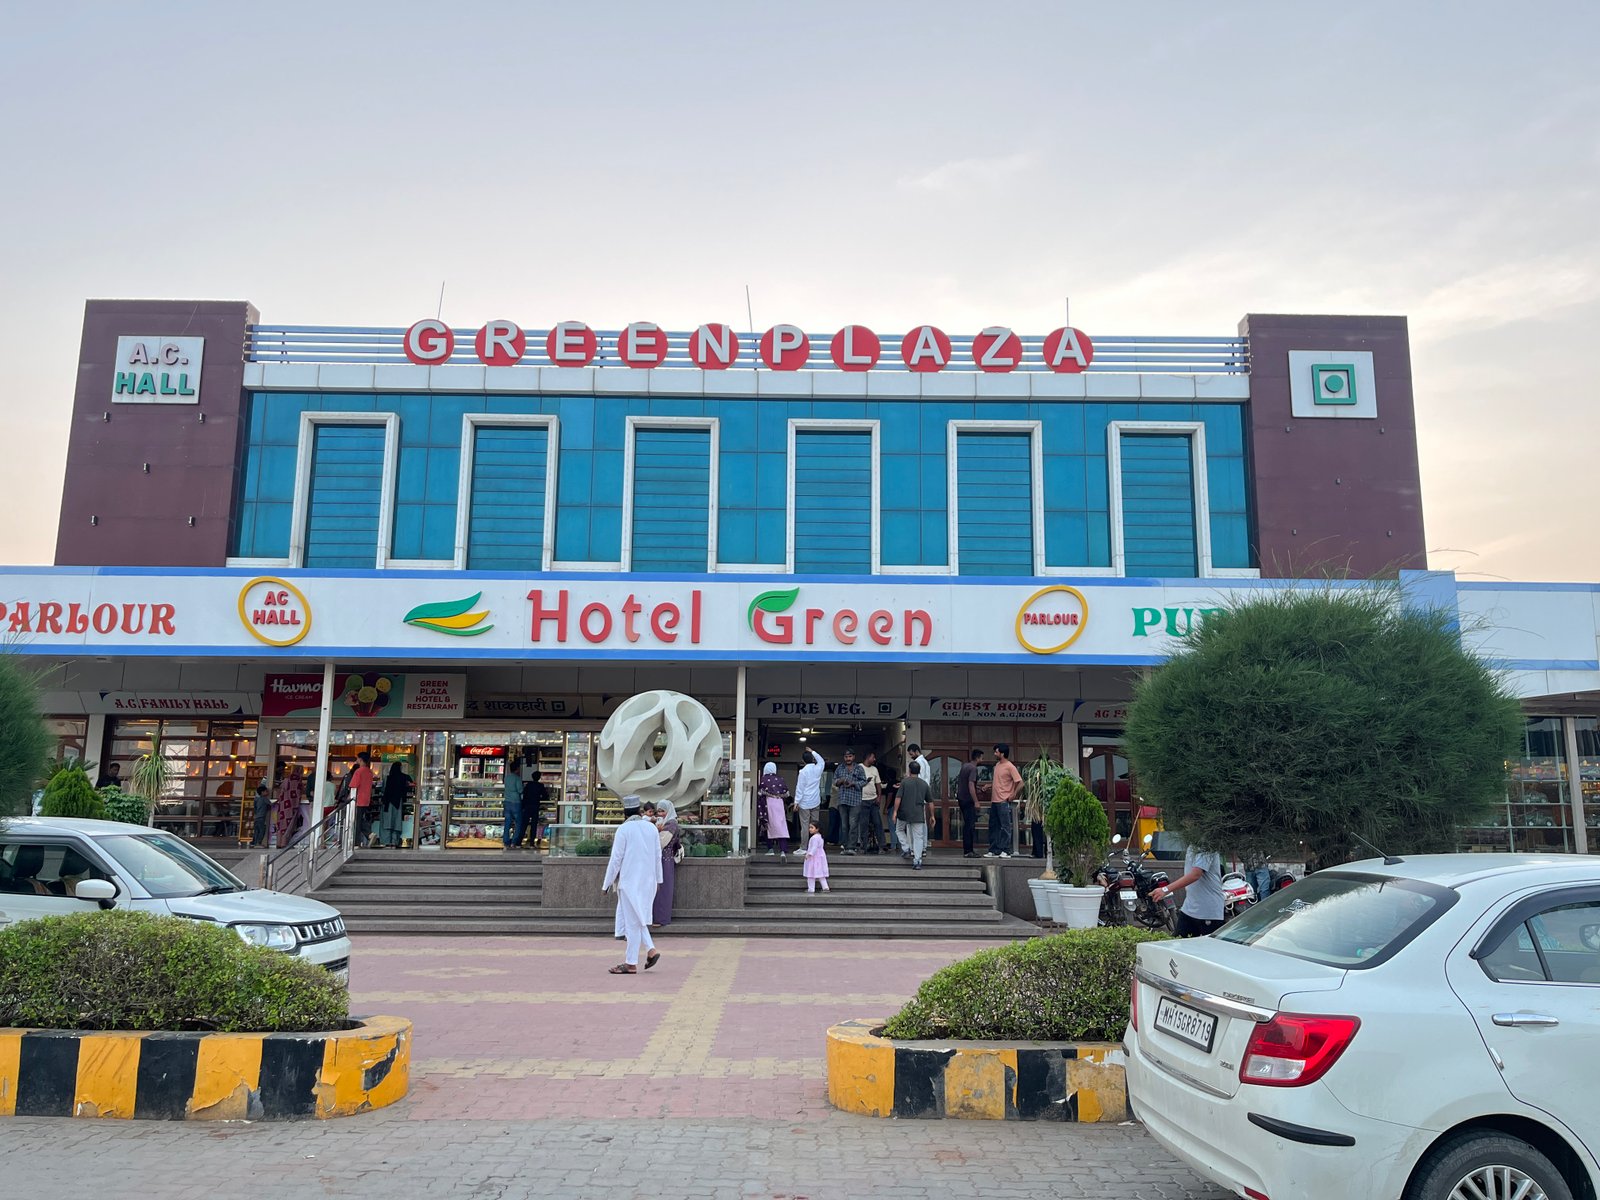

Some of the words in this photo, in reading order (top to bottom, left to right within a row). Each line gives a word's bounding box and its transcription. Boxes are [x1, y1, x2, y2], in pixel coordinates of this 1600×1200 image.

[128, 342, 189, 366] A.C.
[115, 371, 195, 396] HALL
[264, 590, 289, 606] AC
[0, 601, 176, 636] ARLOUR
[252, 609, 301, 625] HALL
[526, 588, 702, 645] Hotel
[748, 588, 932, 646] Green
[1023, 612, 1079, 626] PARLOUR
[270, 678, 324, 694] Havmo
[420, 680, 449, 688] GREEN
[415, 695, 444, 703] HOTEL
[419, 688, 448, 696] PLAZA
[193, 699, 229, 710] HALL
[406, 703, 459, 711] RESTAURANT
[484, 698, 548, 713] शाकाहारी
[771, 702, 820, 715] PURE
[826, 702, 866, 715] VEG.
[942, 701, 991, 711] GUEST
[996, 702, 1048, 712] HOUSE
[1162, 1005, 1212, 1042] MH15GR8719
